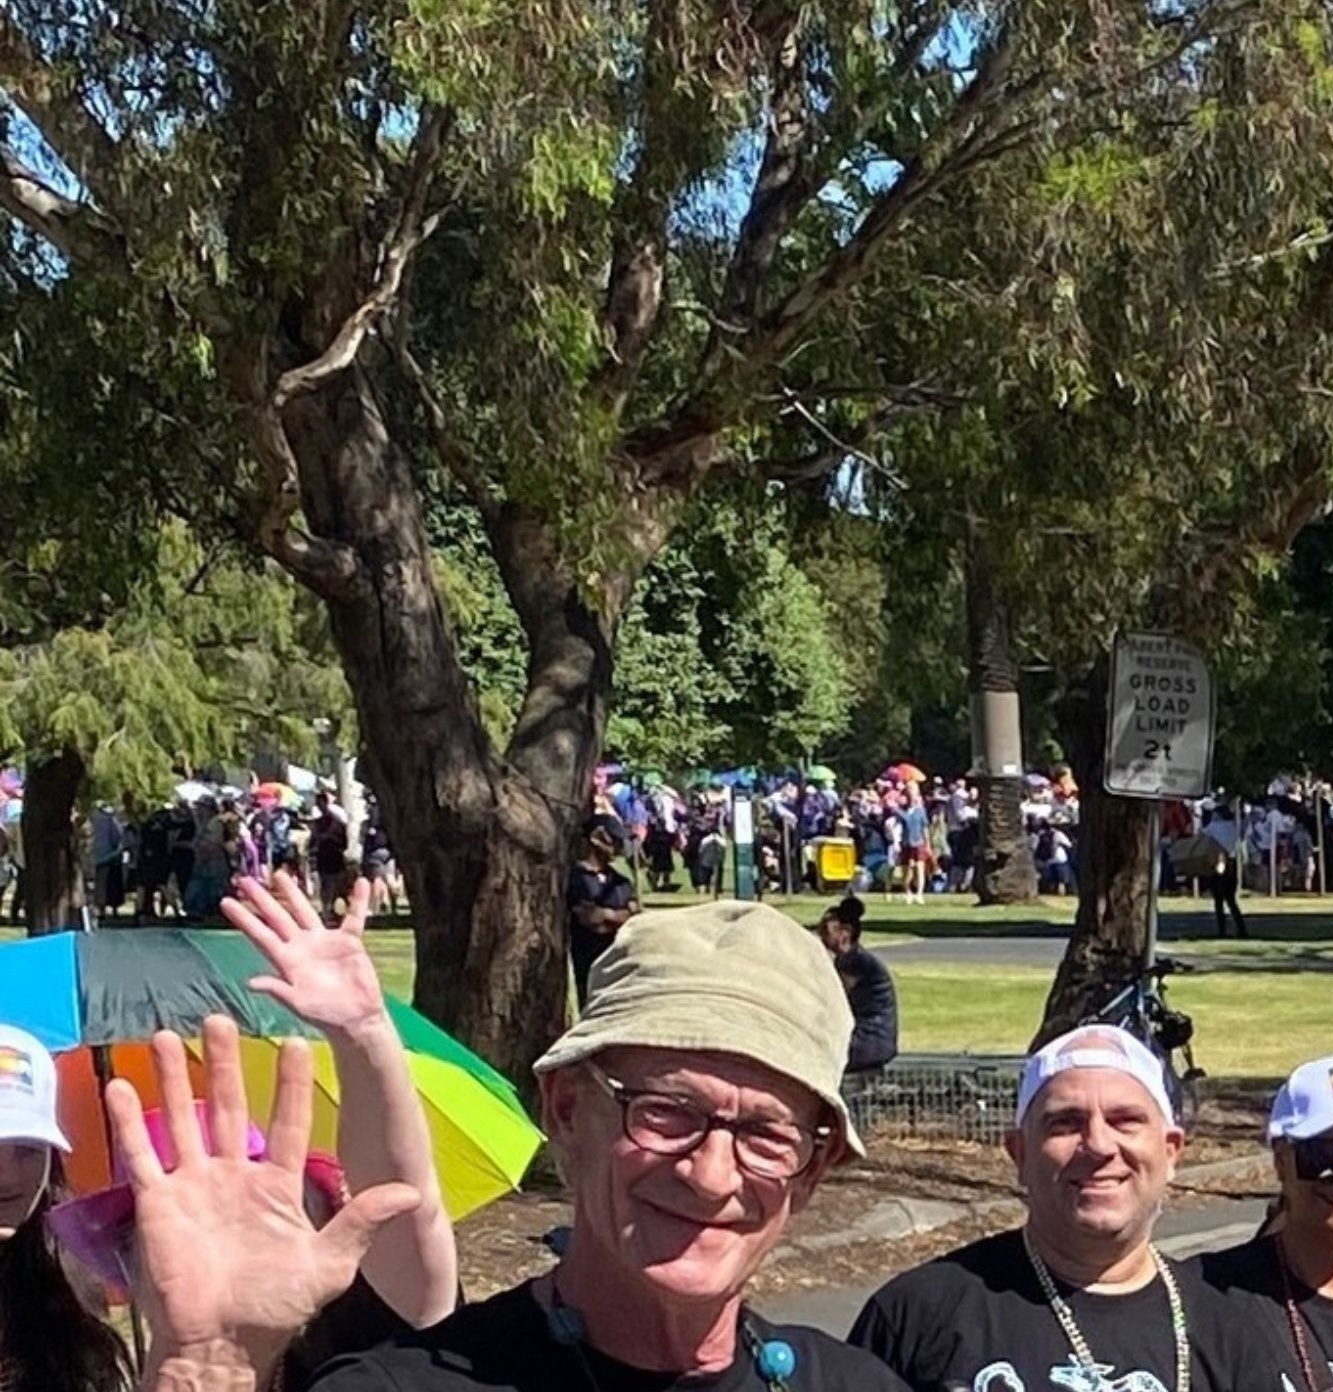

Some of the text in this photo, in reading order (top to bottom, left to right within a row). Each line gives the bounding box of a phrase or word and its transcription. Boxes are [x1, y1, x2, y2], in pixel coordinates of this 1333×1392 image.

[1129, 673, 1197, 694] GROSS
[1135, 695, 1190, 715] LOAD
[1136, 716, 1188, 734] LIMIT
[1144, 739, 1173, 761] 2t
